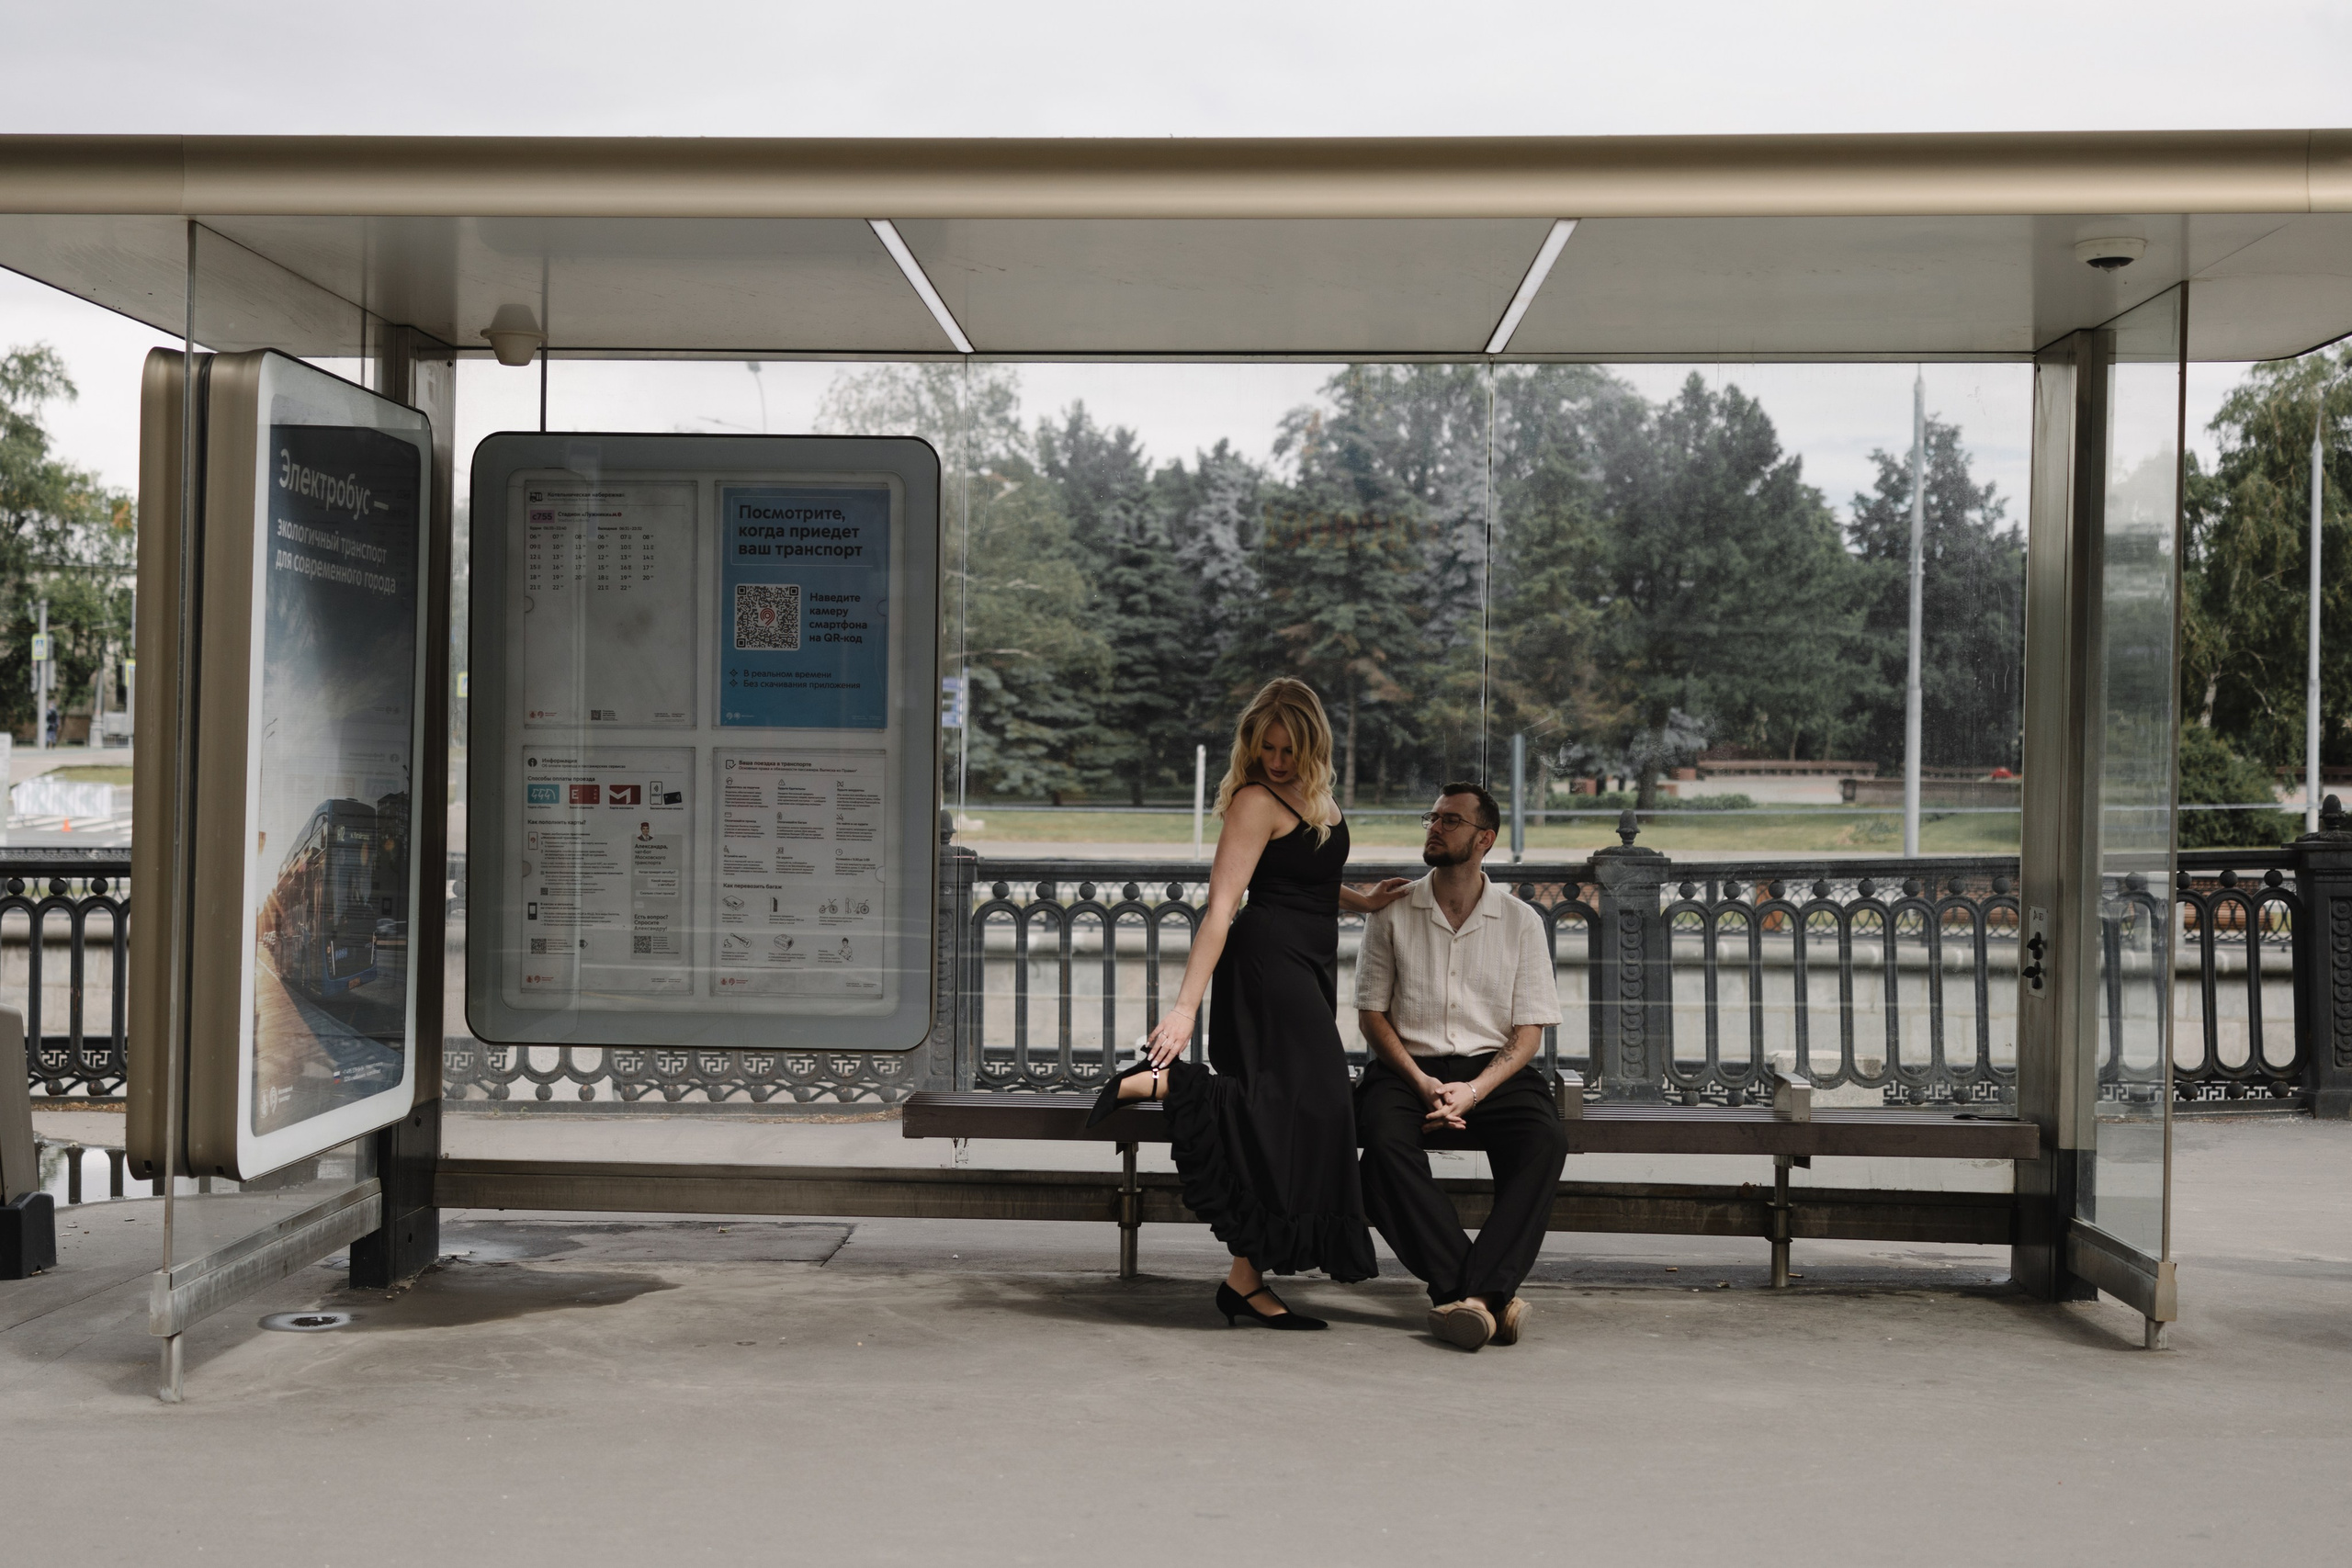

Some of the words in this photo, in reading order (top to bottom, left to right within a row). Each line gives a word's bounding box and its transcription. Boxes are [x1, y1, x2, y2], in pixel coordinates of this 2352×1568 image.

[279, 448, 370, 520] Электробус
[739, 504, 846, 522] Посмотрите,
[739, 526, 785, 539] когда
[789, 526, 860, 540] приедет
[277, 518, 339, 552] экологичный
[341, 537, 387, 568] транспорт
[739, 544, 771, 555] ваш
[775, 544, 863, 558] транспорт
[275, 548, 292, 570] для
[293, 556, 362, 587] современного
[364, 570, 396, 595] города
[809, 592, 861, 603] Наведите
[809, 608, 848, 617] камеру
[809, 620, 867, 631] смартфона
[809, 635, 821, 643] на
[823, 634, 863, 644] QR-код
[752, 671, 793, 679] реальном
[795, 671, 831, 680] времени
[743, 680, 758, 688] Без
[809, 682, 861, 690] приложения
